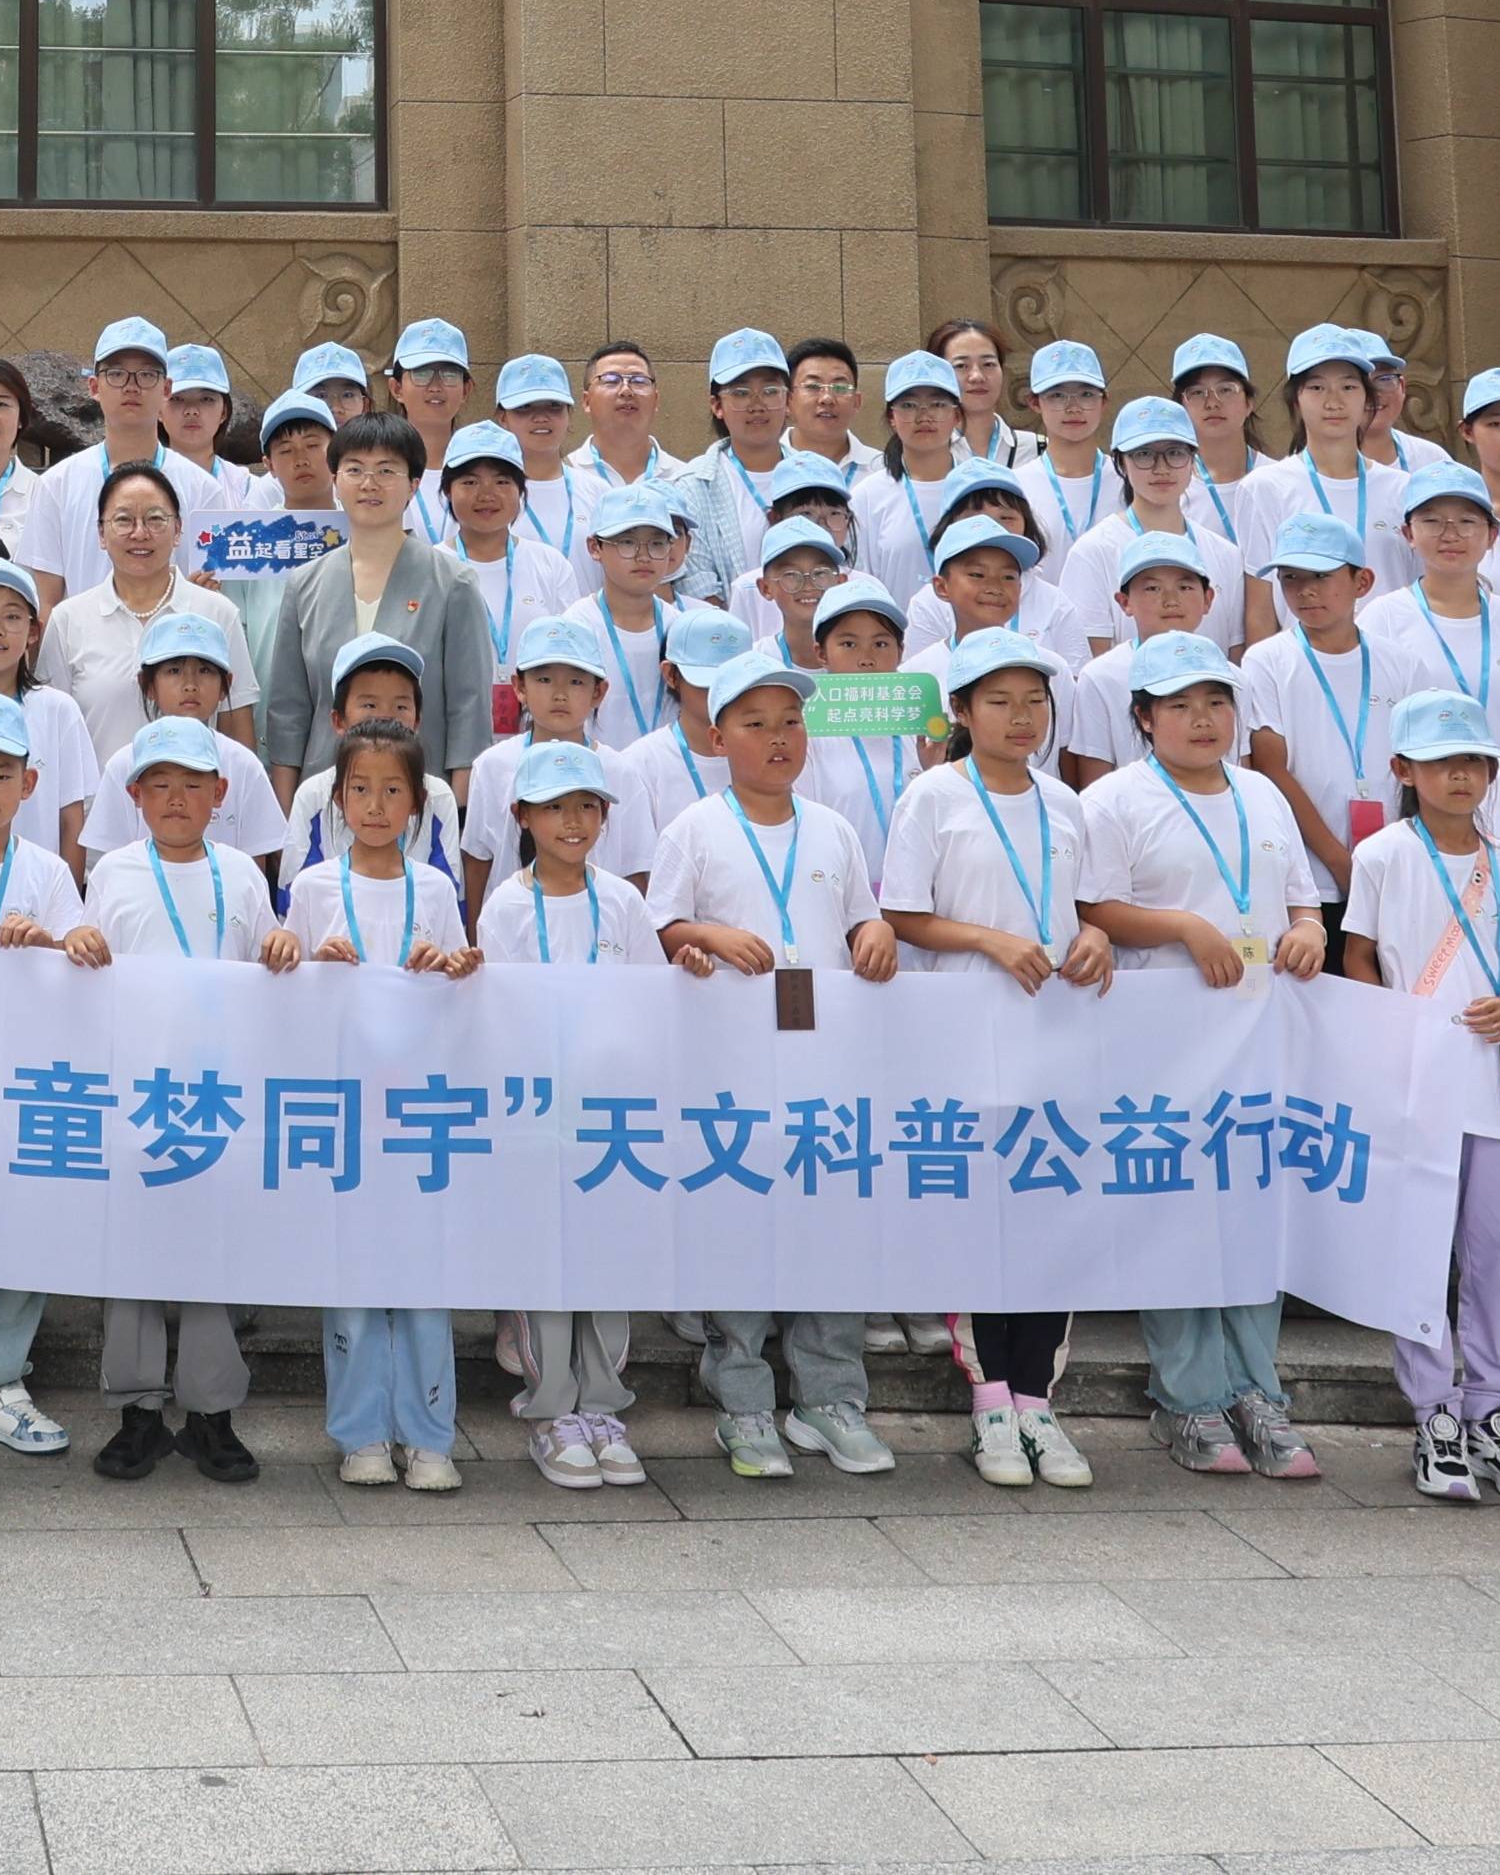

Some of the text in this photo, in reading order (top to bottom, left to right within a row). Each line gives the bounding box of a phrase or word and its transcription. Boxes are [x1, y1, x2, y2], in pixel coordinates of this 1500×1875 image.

[226, 531, 325, 560] 益起看星空
